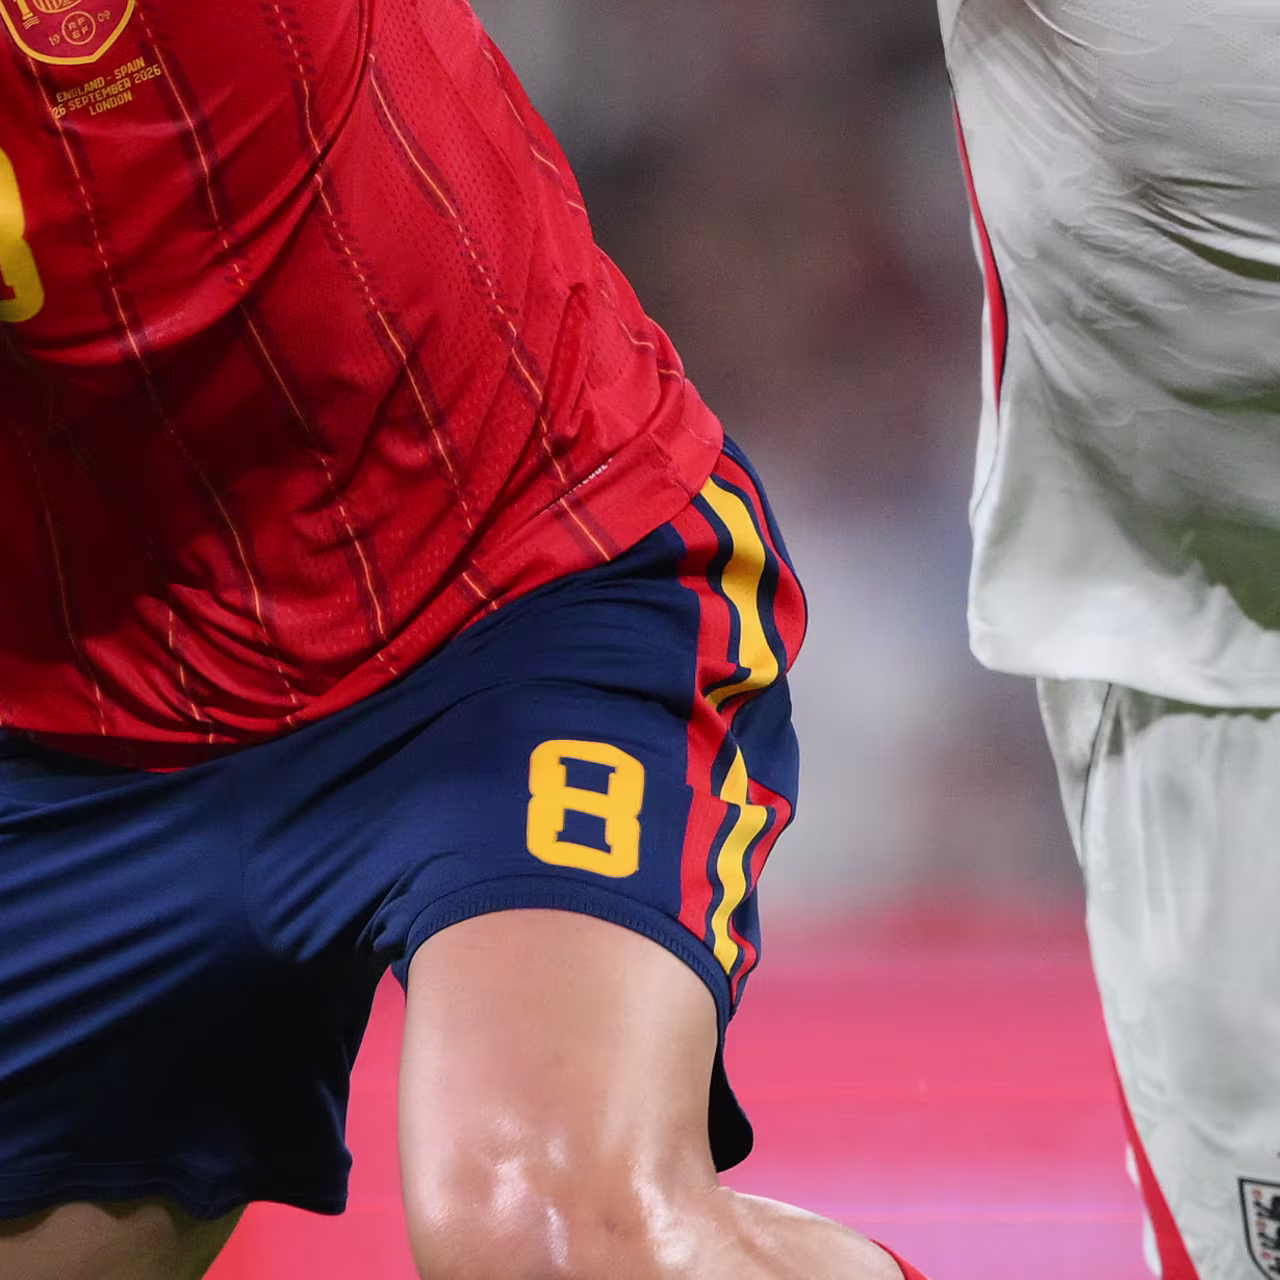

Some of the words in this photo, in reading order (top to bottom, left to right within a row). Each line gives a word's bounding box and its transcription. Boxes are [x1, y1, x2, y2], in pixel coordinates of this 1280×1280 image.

[51, 103, 67, 119] 26
[67, 77, 131, 111] SEPTEMBER
[133, 64, 162, 84] 2026
[56, 76, 105, 102] ENGLAND
[114, 56, 145, 80] SPAIN
[88, 89, 133, 116] LONDON
[526, 739, 645, 878] 8
